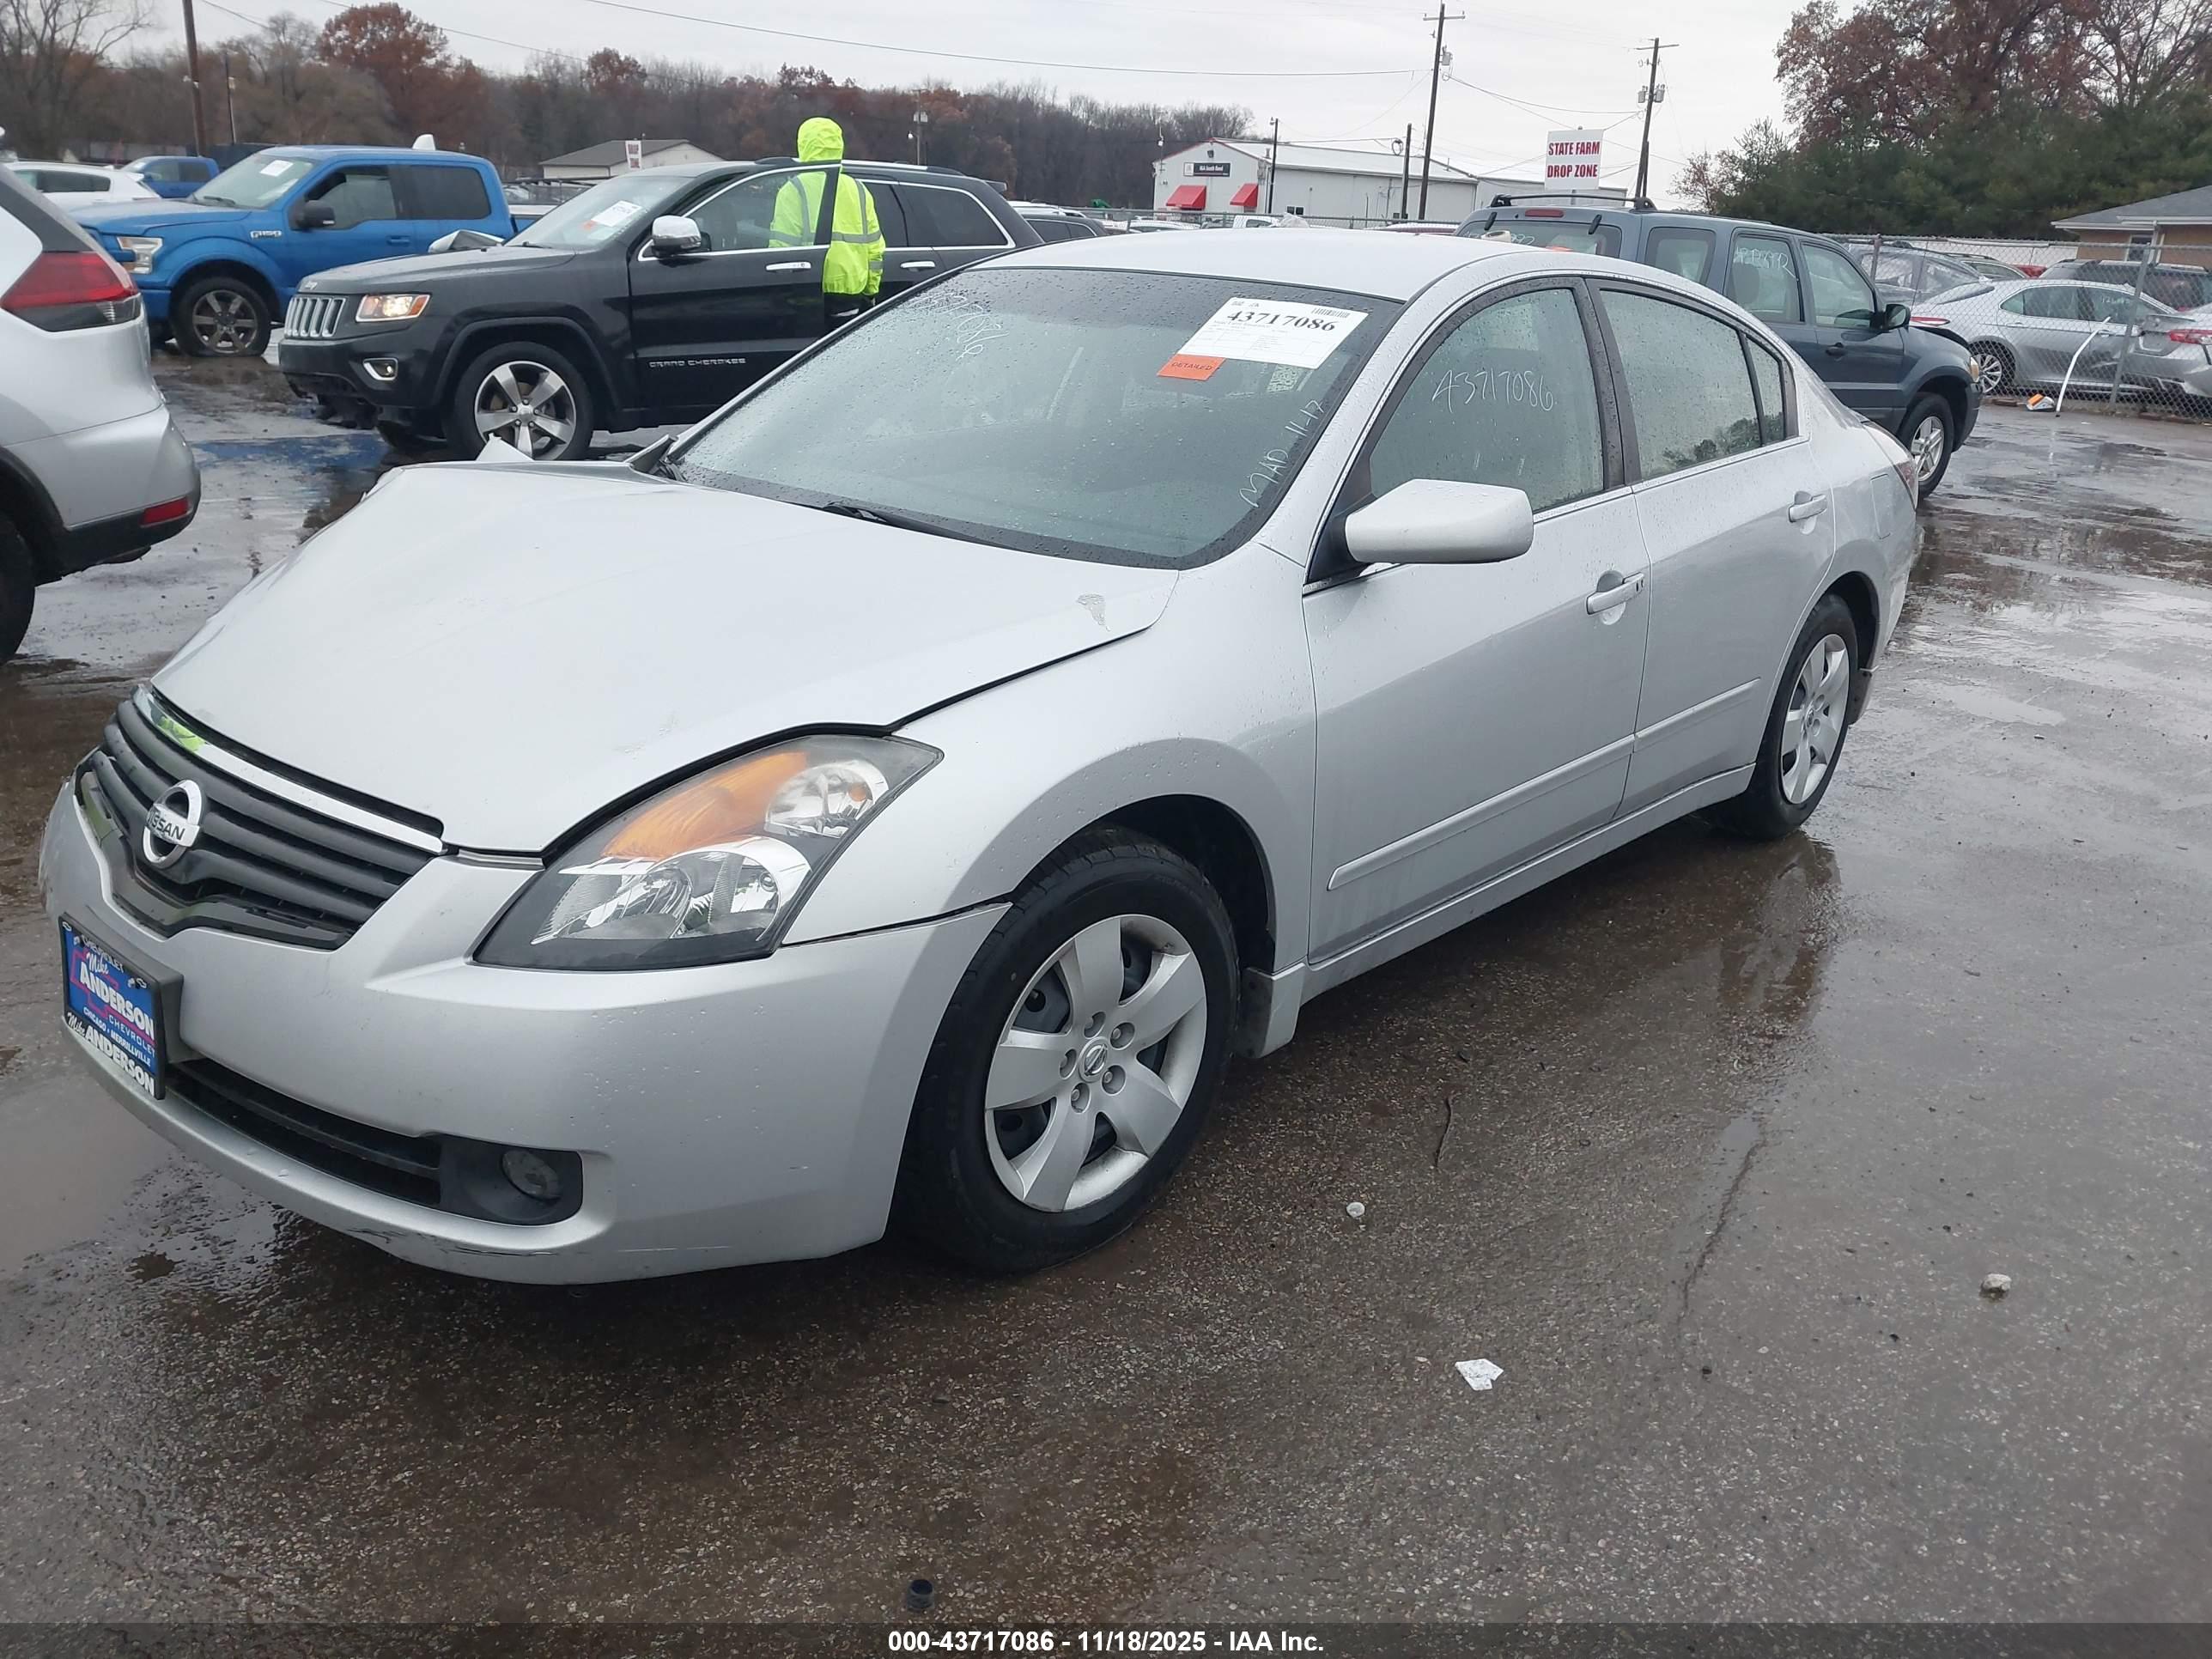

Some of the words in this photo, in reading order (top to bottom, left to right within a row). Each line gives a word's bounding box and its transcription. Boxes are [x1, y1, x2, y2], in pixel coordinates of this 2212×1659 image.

[1548, 142, 1574, 155] STATE
[1575, 141, 1600, 155] FARM
[1547, 164, 1572, 178] DROP
[1574, 164, 1598, 177] ZONE
[1227, 310, 1337, 331] 43717086
[1431, 368, 1553, 413] 43717086
[1239, 449, 1289, 507] MAD
[86, 951, 109, 975] Mike
[80, 961, 155, 1041] ANDERSON
[67, 1012, 86, 1038] Mike
[85, 1024, 155, 1097] ANDERSON
[83, 1006, 106, 1031] CHICAGO
[110, 1030, 151, 1067] MERRILLVILLE
[109, 1014, 156, 1058] CHEVROLET
